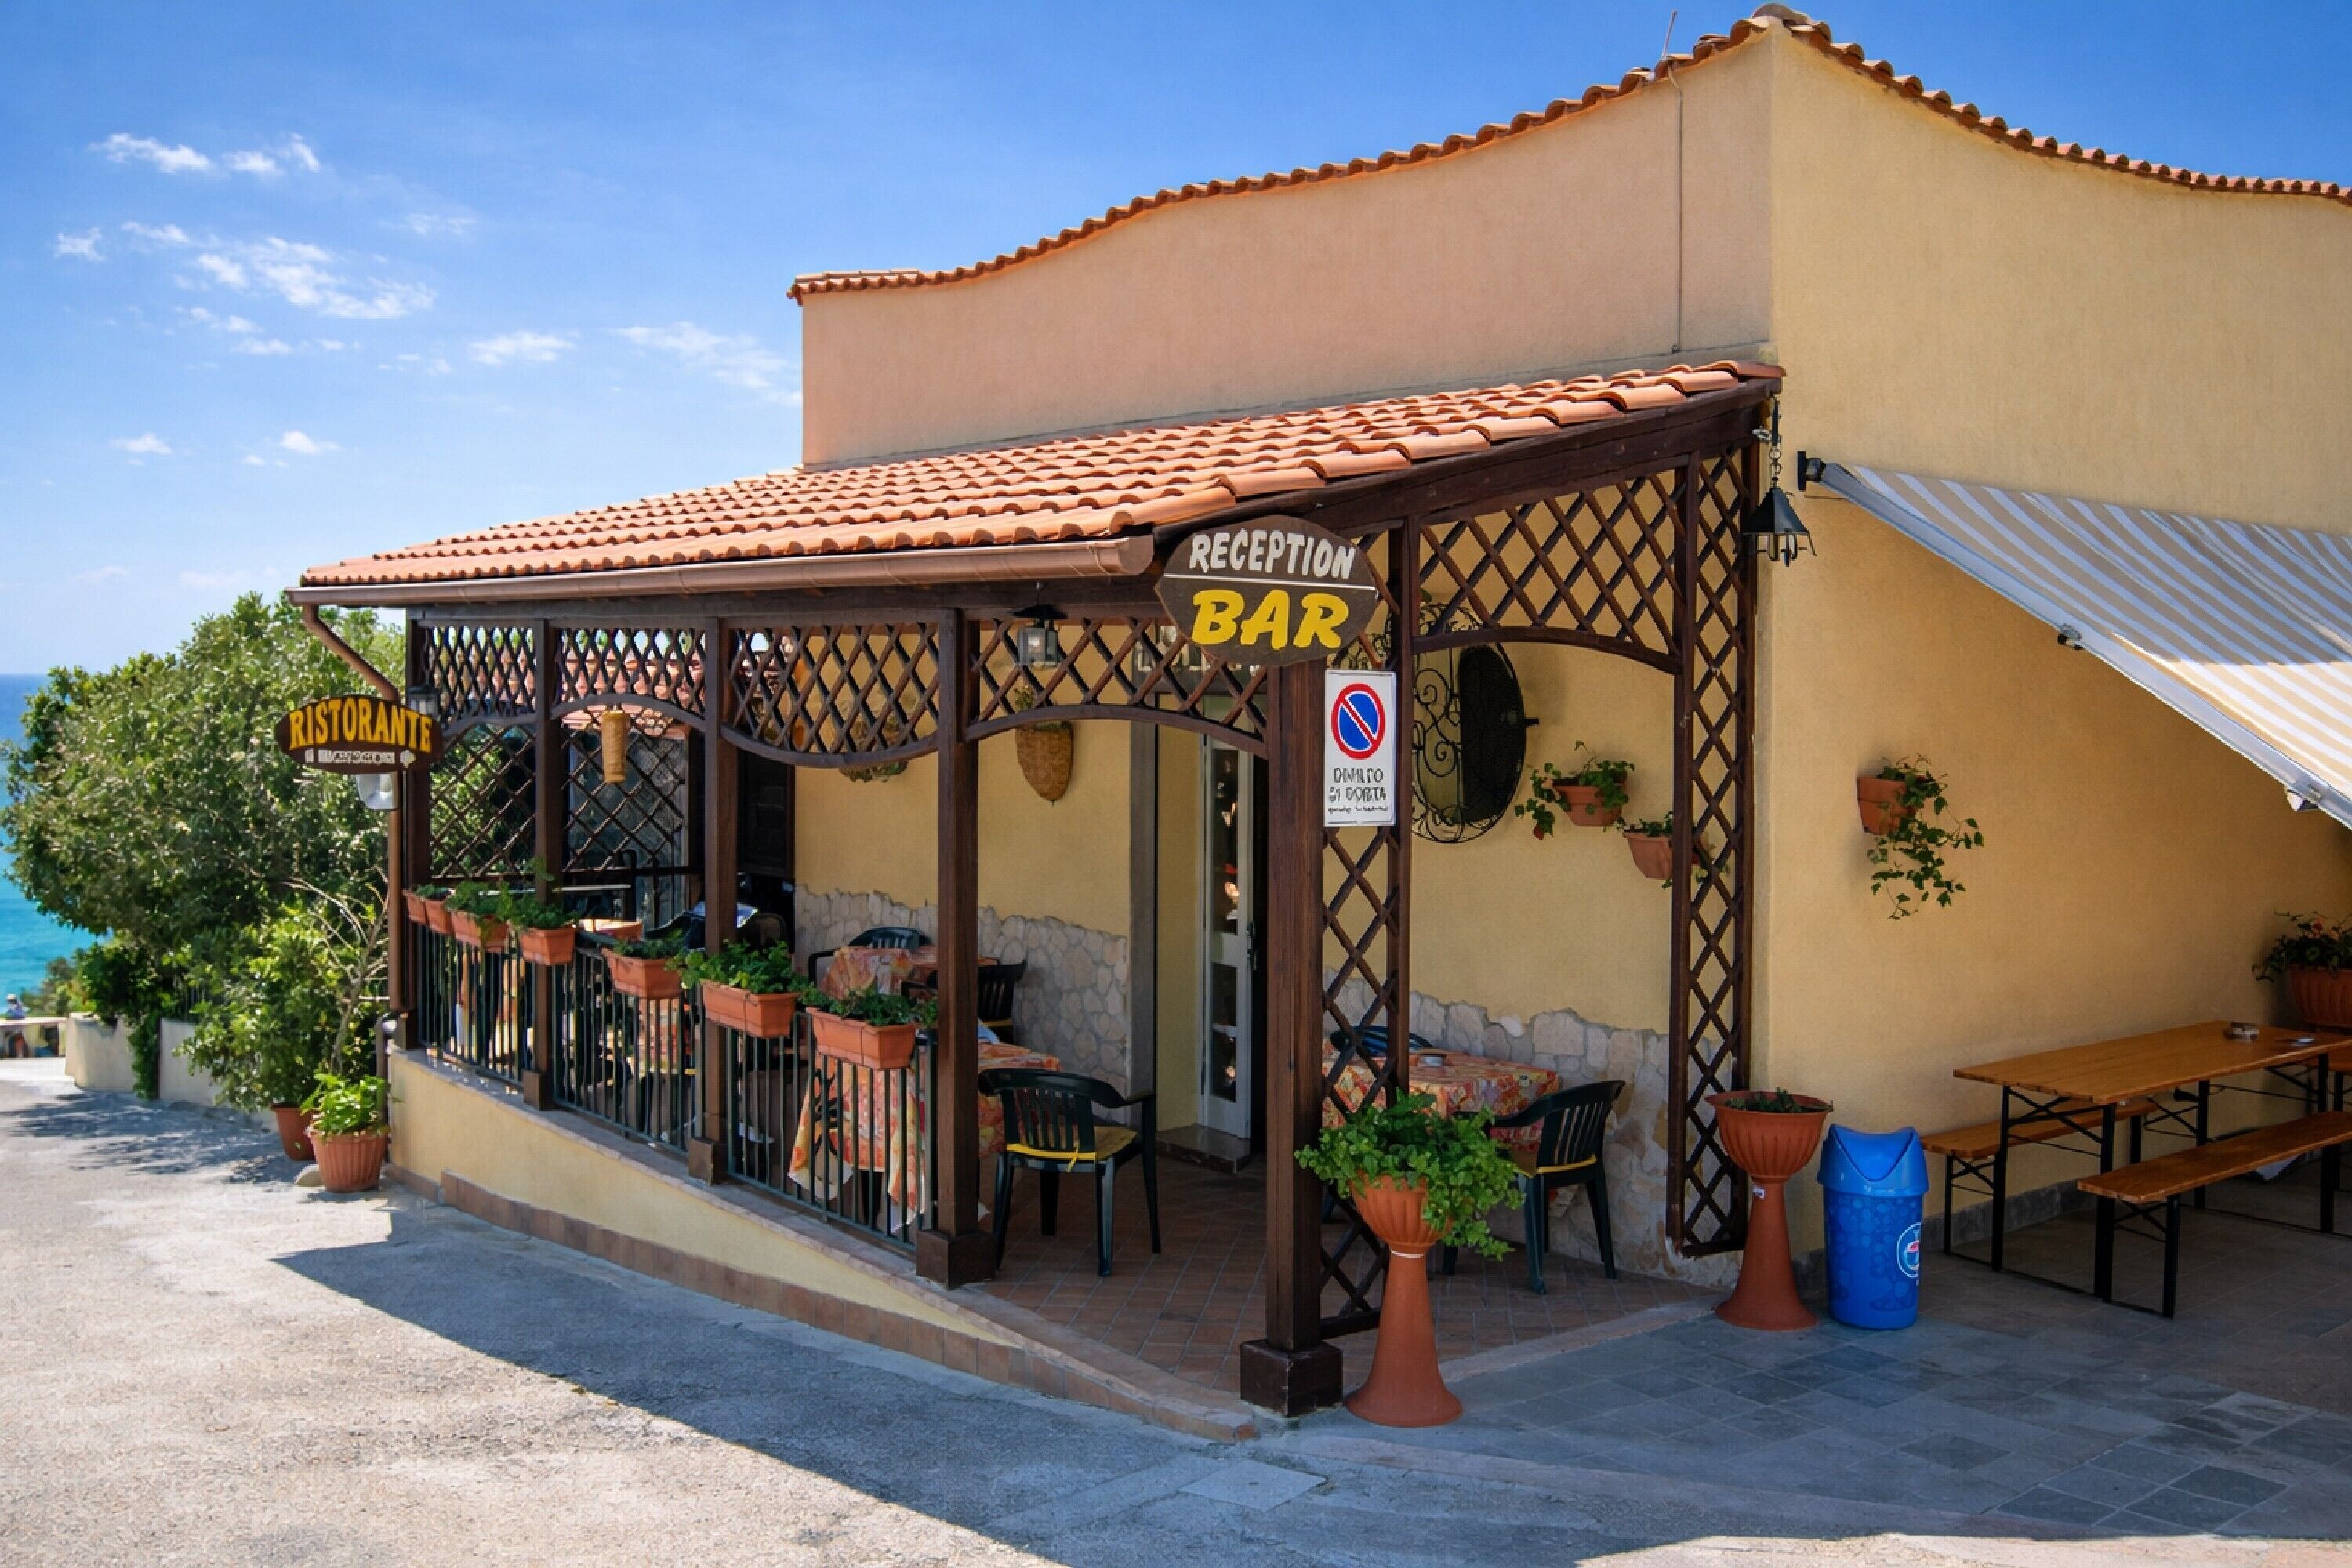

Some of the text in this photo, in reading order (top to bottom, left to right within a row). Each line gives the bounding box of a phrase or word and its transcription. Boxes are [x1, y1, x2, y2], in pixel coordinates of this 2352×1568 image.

[1188, 528, 1356, 580] RECEPTION
[1191, 589, 1350, 651] BAR
[288, 697, 433, 753] RISTORANTE
